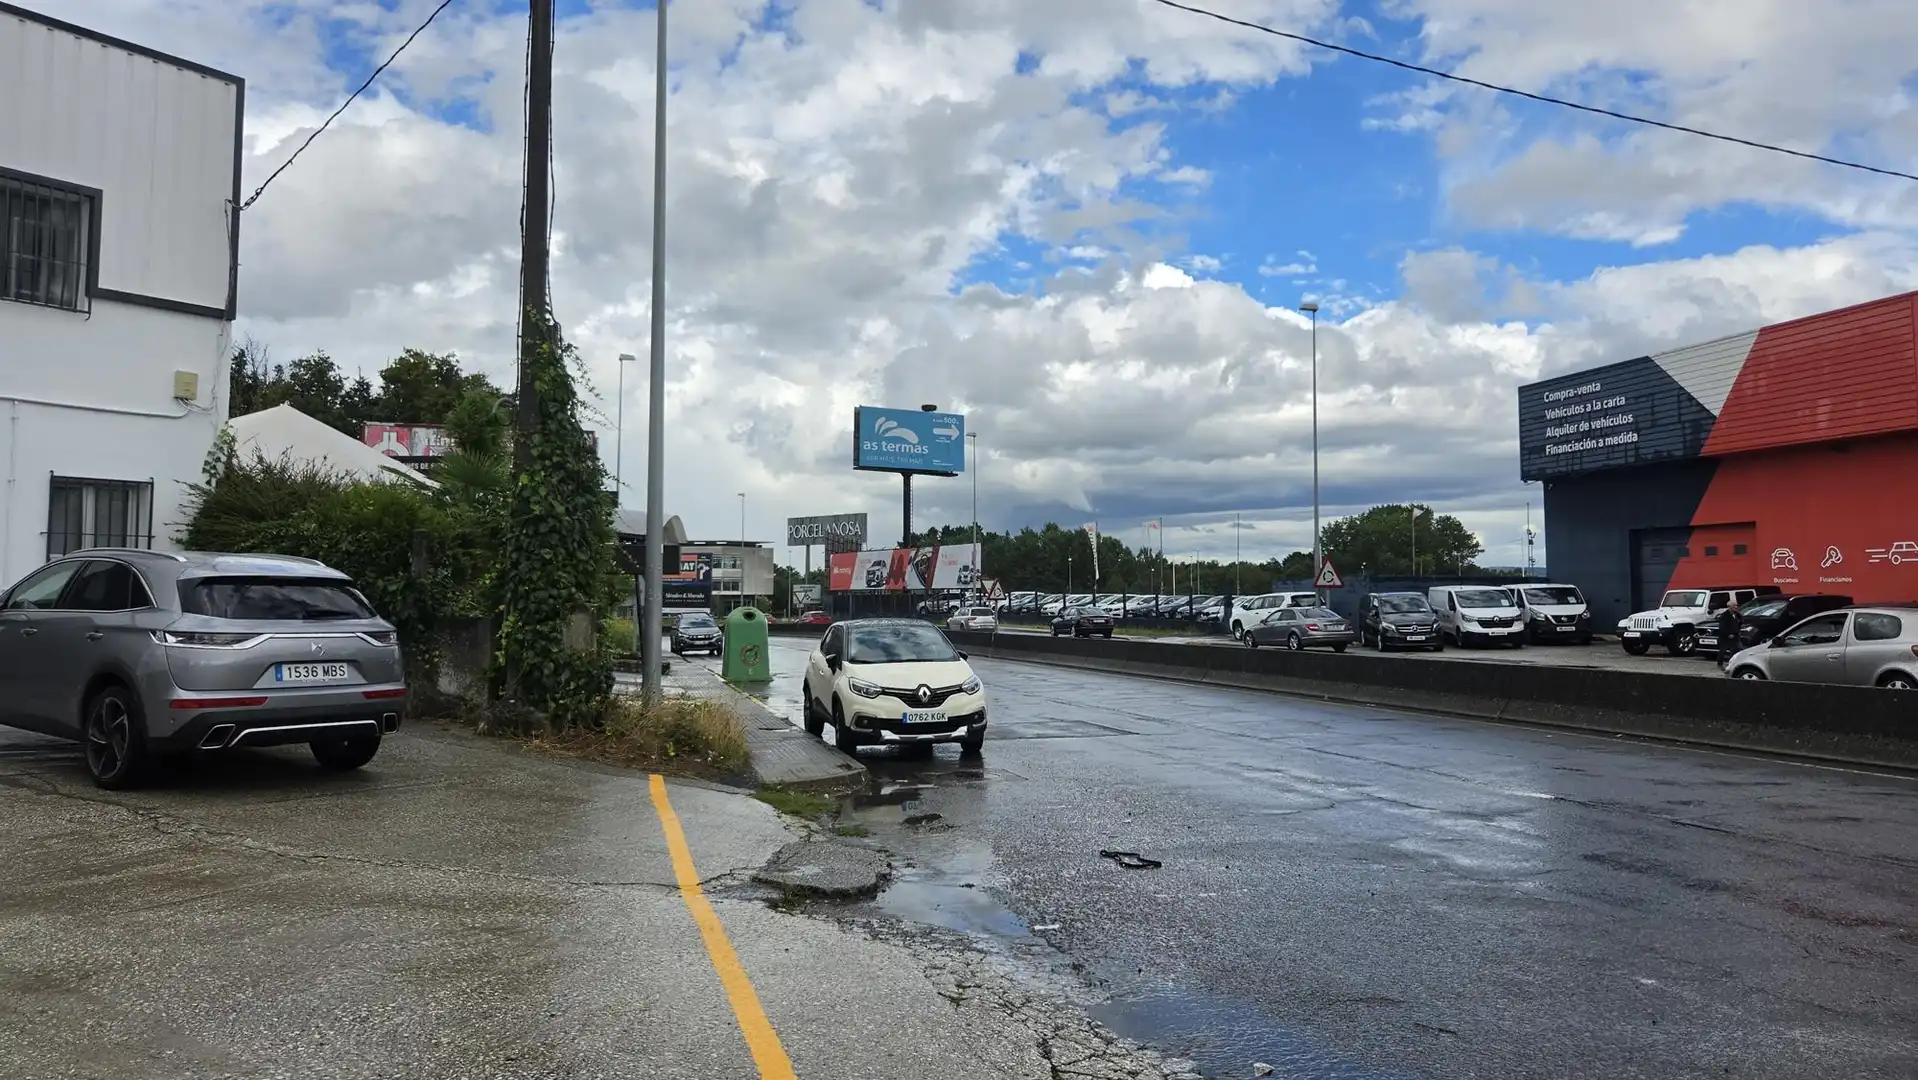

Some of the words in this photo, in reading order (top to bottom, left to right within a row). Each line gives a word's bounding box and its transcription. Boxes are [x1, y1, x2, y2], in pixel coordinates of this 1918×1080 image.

[1544, 382, 1601, 402] Compra-venta
[1545, 404, 1585, 420] Vehículos
[1586, 403, 1592, 412] a
[1593, 400, 1601, 411] la
[1603, 395, 1625, 409] carta
[1546, 424, 1578, 438] Alquiler
[1579, 421, 1590, 432] de
[1591, 413, 1634, 430] vehículos
[863, 441, 879, 451] as
[881, 441, 929, 455] termas
[1546, 439, 1597, 455] Financiación
[1598, 439, 1604, 447] a
[1605, 431, 1638, 447] medida
[788, 521, 861, 539] PORCELANOSA
[287, 666, 318, 678] 1536
[322, 665, 346, 677] MBS
[931, 712, 946, 720] KGK
